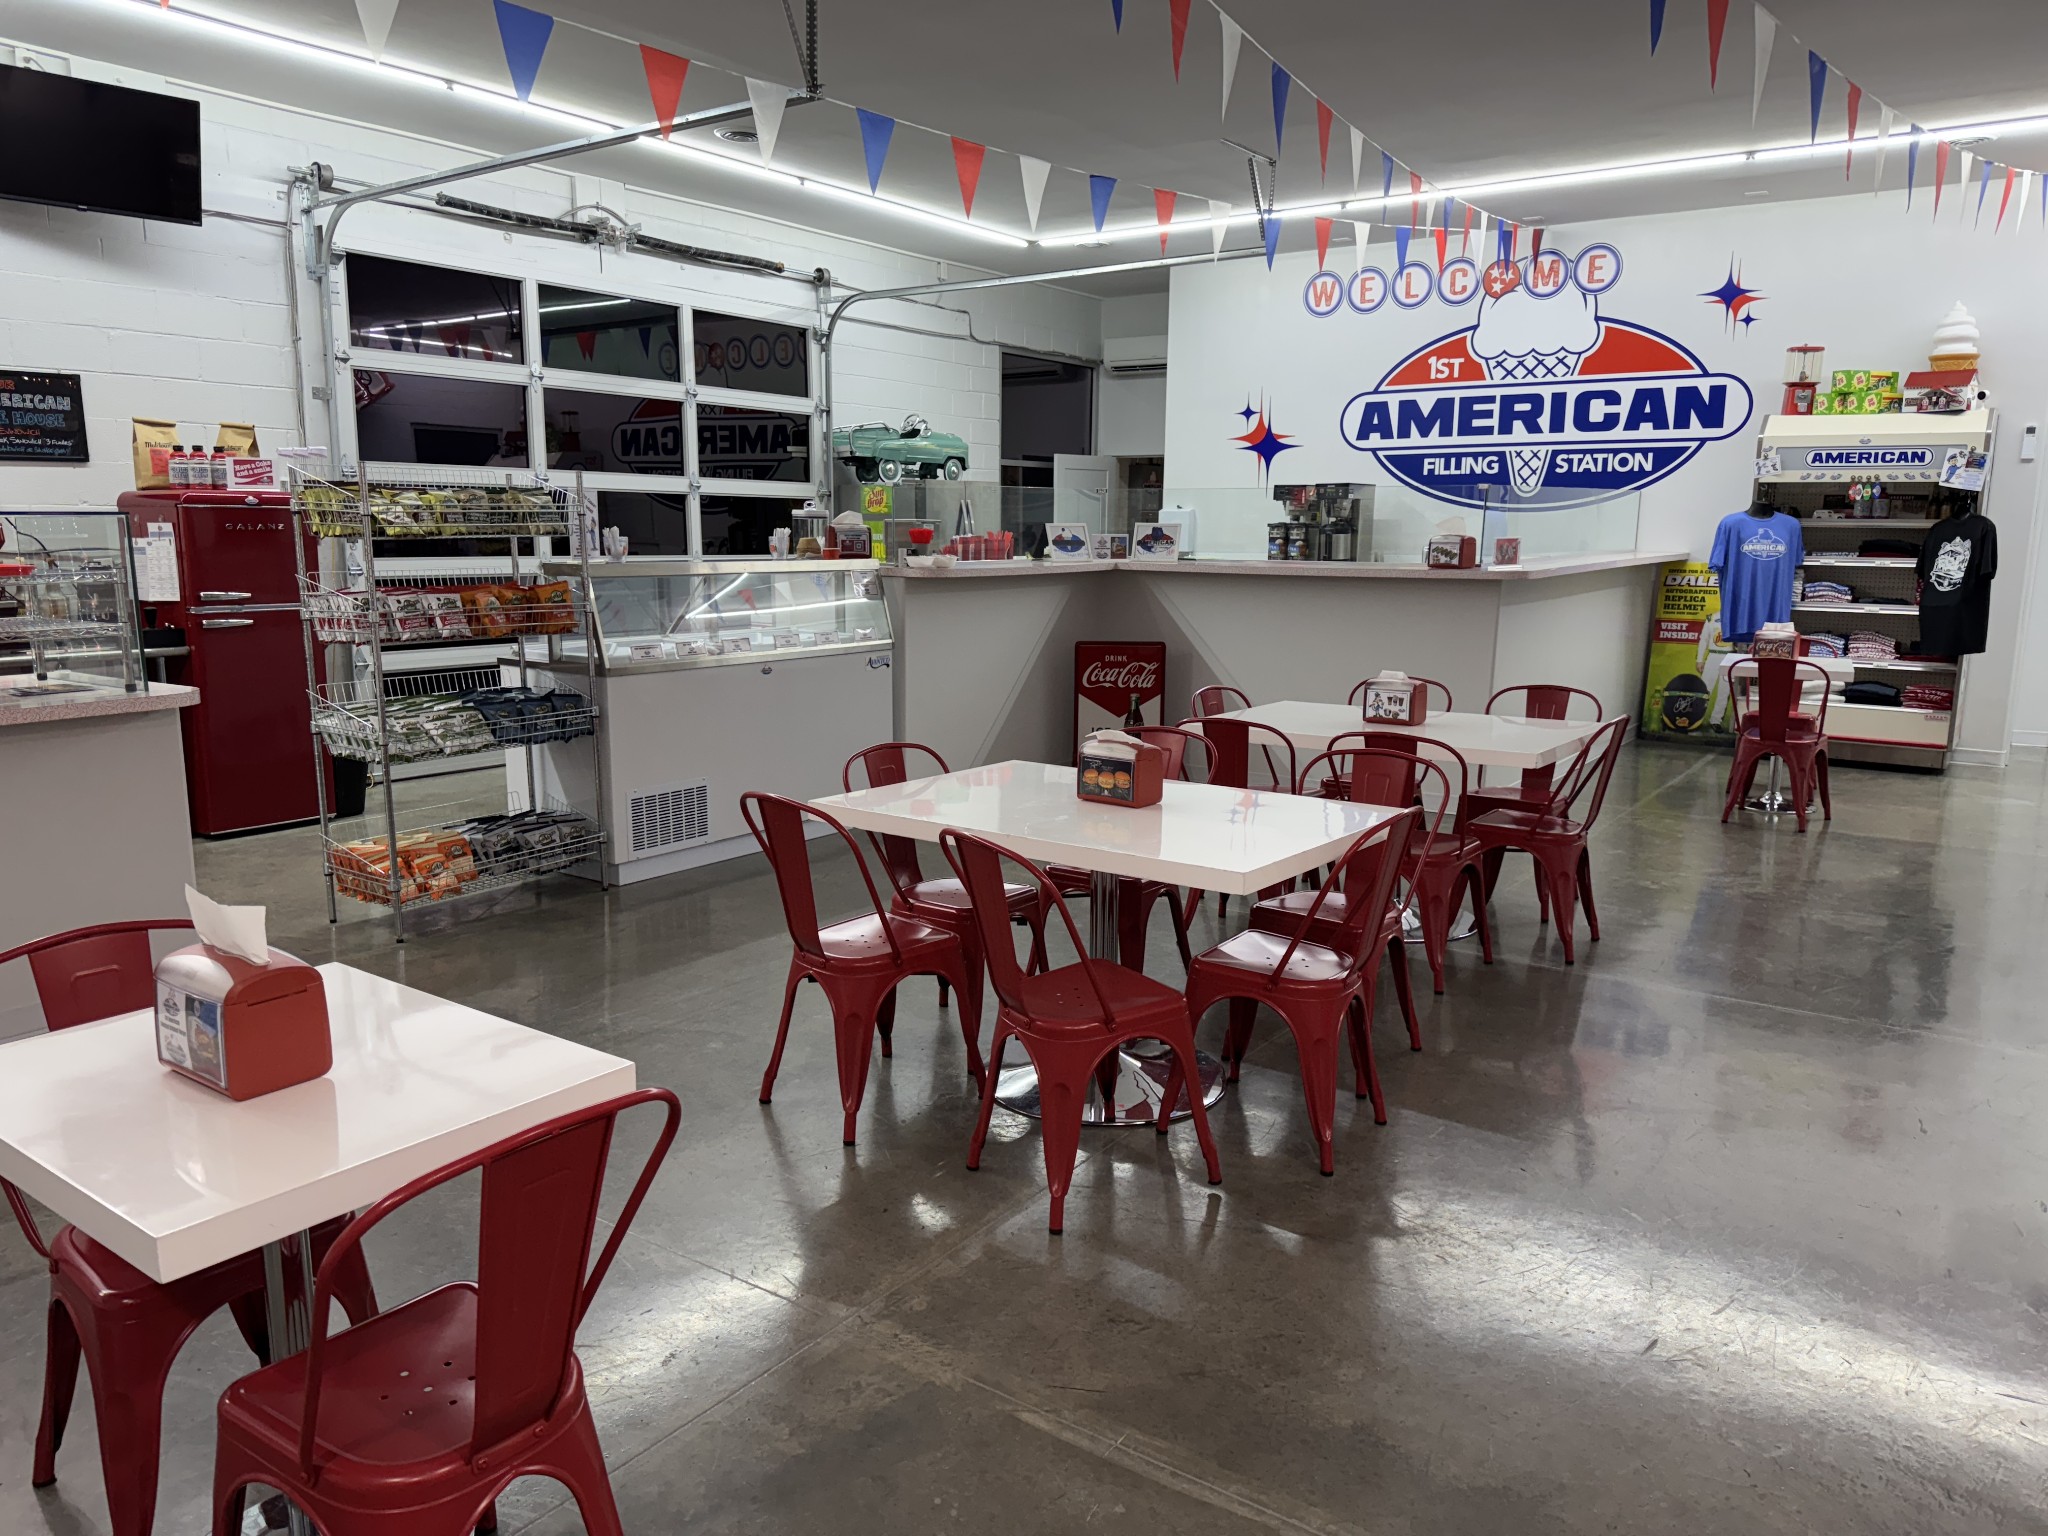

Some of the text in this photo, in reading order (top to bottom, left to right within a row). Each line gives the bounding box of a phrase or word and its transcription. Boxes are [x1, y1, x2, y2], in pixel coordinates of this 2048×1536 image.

[1428, 356, 1464, 379] 1ST
[0, 393, 71, 410] ERICAN
[12, 411, 65, 427] HOUSE
[1355, 385, 1727, 441] AMERICAN
[1422, 452, 1653, 475] FILLING STATION
[1811, 451, 1926, 464] AMERICAN
[1664, 575, 1719, 587] DALE
[1663, 603, 1706, 611] HELMET
[1660, 622, 1689, 630] VISIT
[1659, 631, 1699, 640] INSIDE!
[1082, 661, 1160, 688] Coca-Cola
